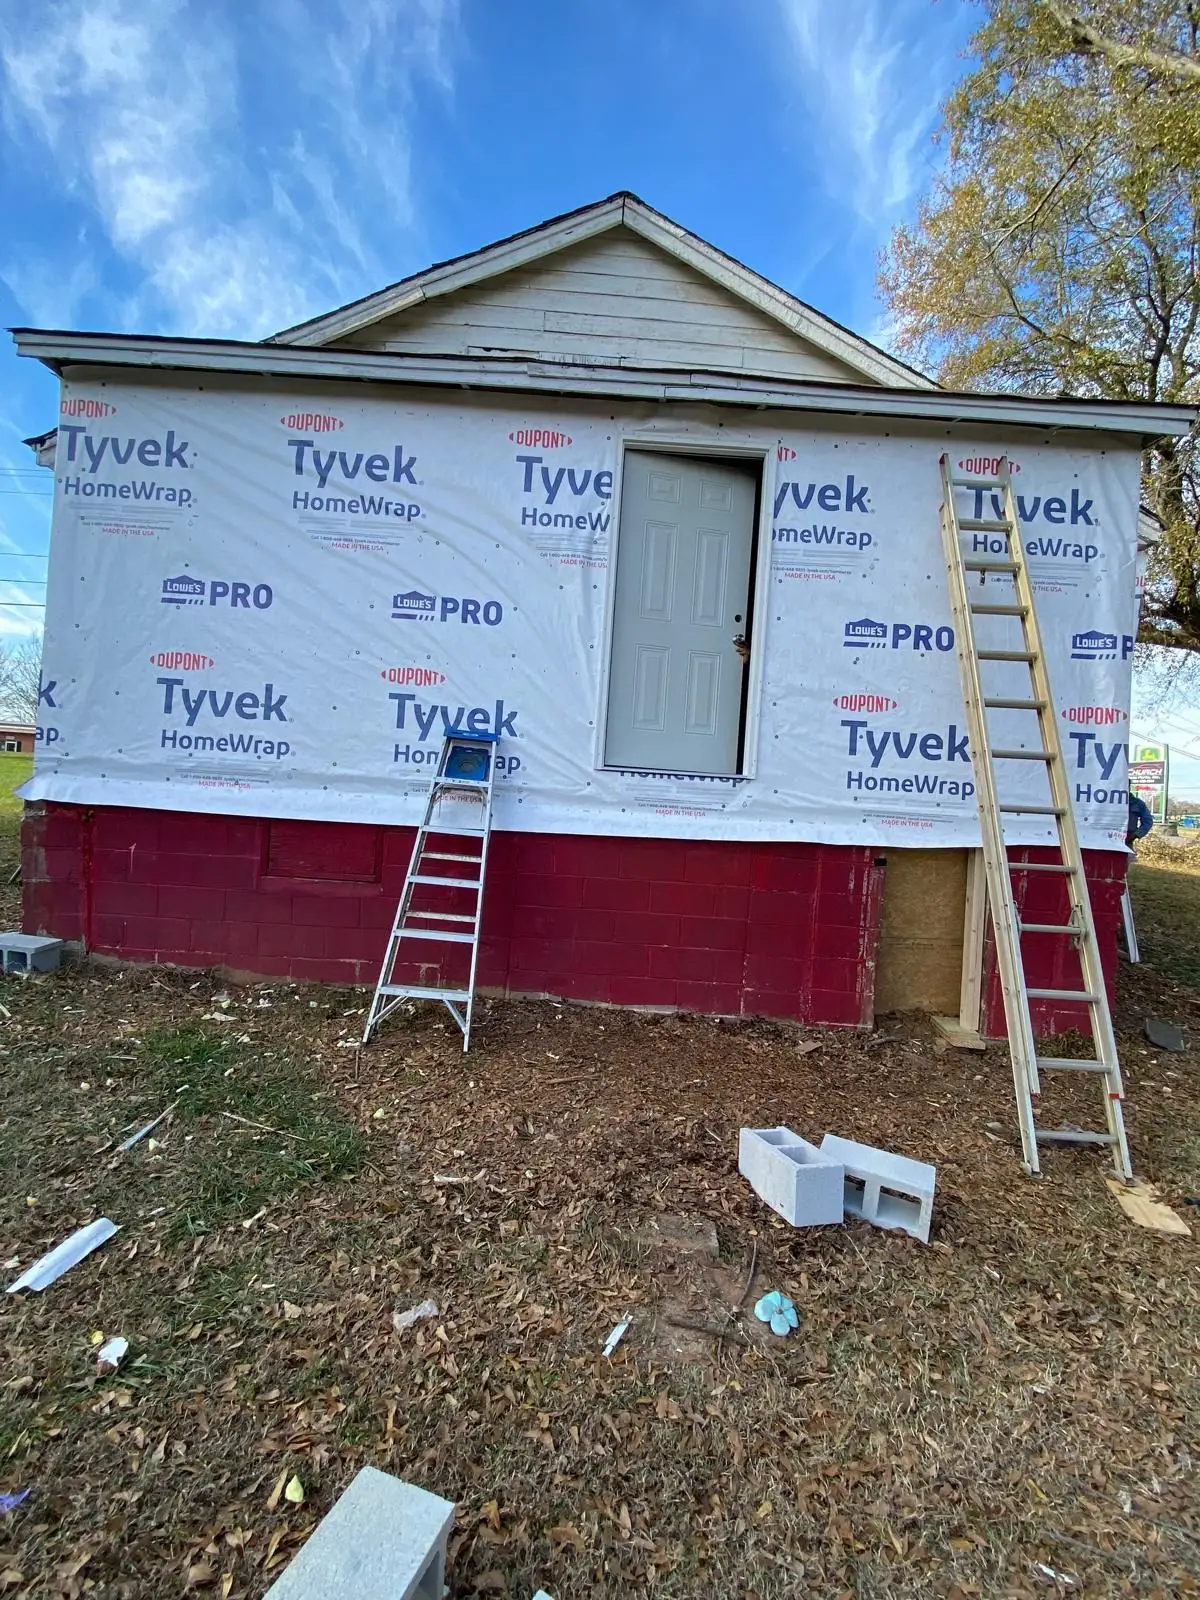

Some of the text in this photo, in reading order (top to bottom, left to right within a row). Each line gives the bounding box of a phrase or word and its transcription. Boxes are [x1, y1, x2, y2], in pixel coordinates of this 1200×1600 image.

[60, 400, 110, 418] DUPONT
[287, 413, 338, 432] DUPONT
[59, 424, 189, 474] Tyvek
[516, 429, 566, 448] DUPONT
[287, 439, 418, 489] Tyvek
[966, 458, 1014, 476] DUPOT
[64, 476, 192, 508] HomeWrap
[292, 490, 421, 522] HomeWrap
[521, 506, 611, 532] HomeW
[102, 527, 120, 535] MADE
[129, 528, 141, 536] THE
[331, 541, 350, 549] MADE
[351, 542, 358, 550] IN
[359, 543, 370, 551] THE
[371, 544, 384, 552] USA
[972, 533, 1099, 563] HoeWrap
[167, 581, 273, 609] LOWE'S PRO
[397, 597, 503, 626] LOWE'S PRO
[849, 624, 955, 651] LOWE'S PRO
[1076, 637, 1113, 648] LOWE'S
[157, 652, 208, 670] DUPONT
[388, 668, 439, 686] DUPONT
[156, 677, 288, 726] Tyvek
[841, 694, 891, 713] DUPONT
[388, 692, 518, 741] Tyvek
[1069, 706, 1121, 725] DUPONT
[161, 729, 291, 760] HomeWrap
[841, 720, 971, 768] Tyvek
[846, 771, 975, 800] HomeWrap
[655, 808, 673, 816] MADE
